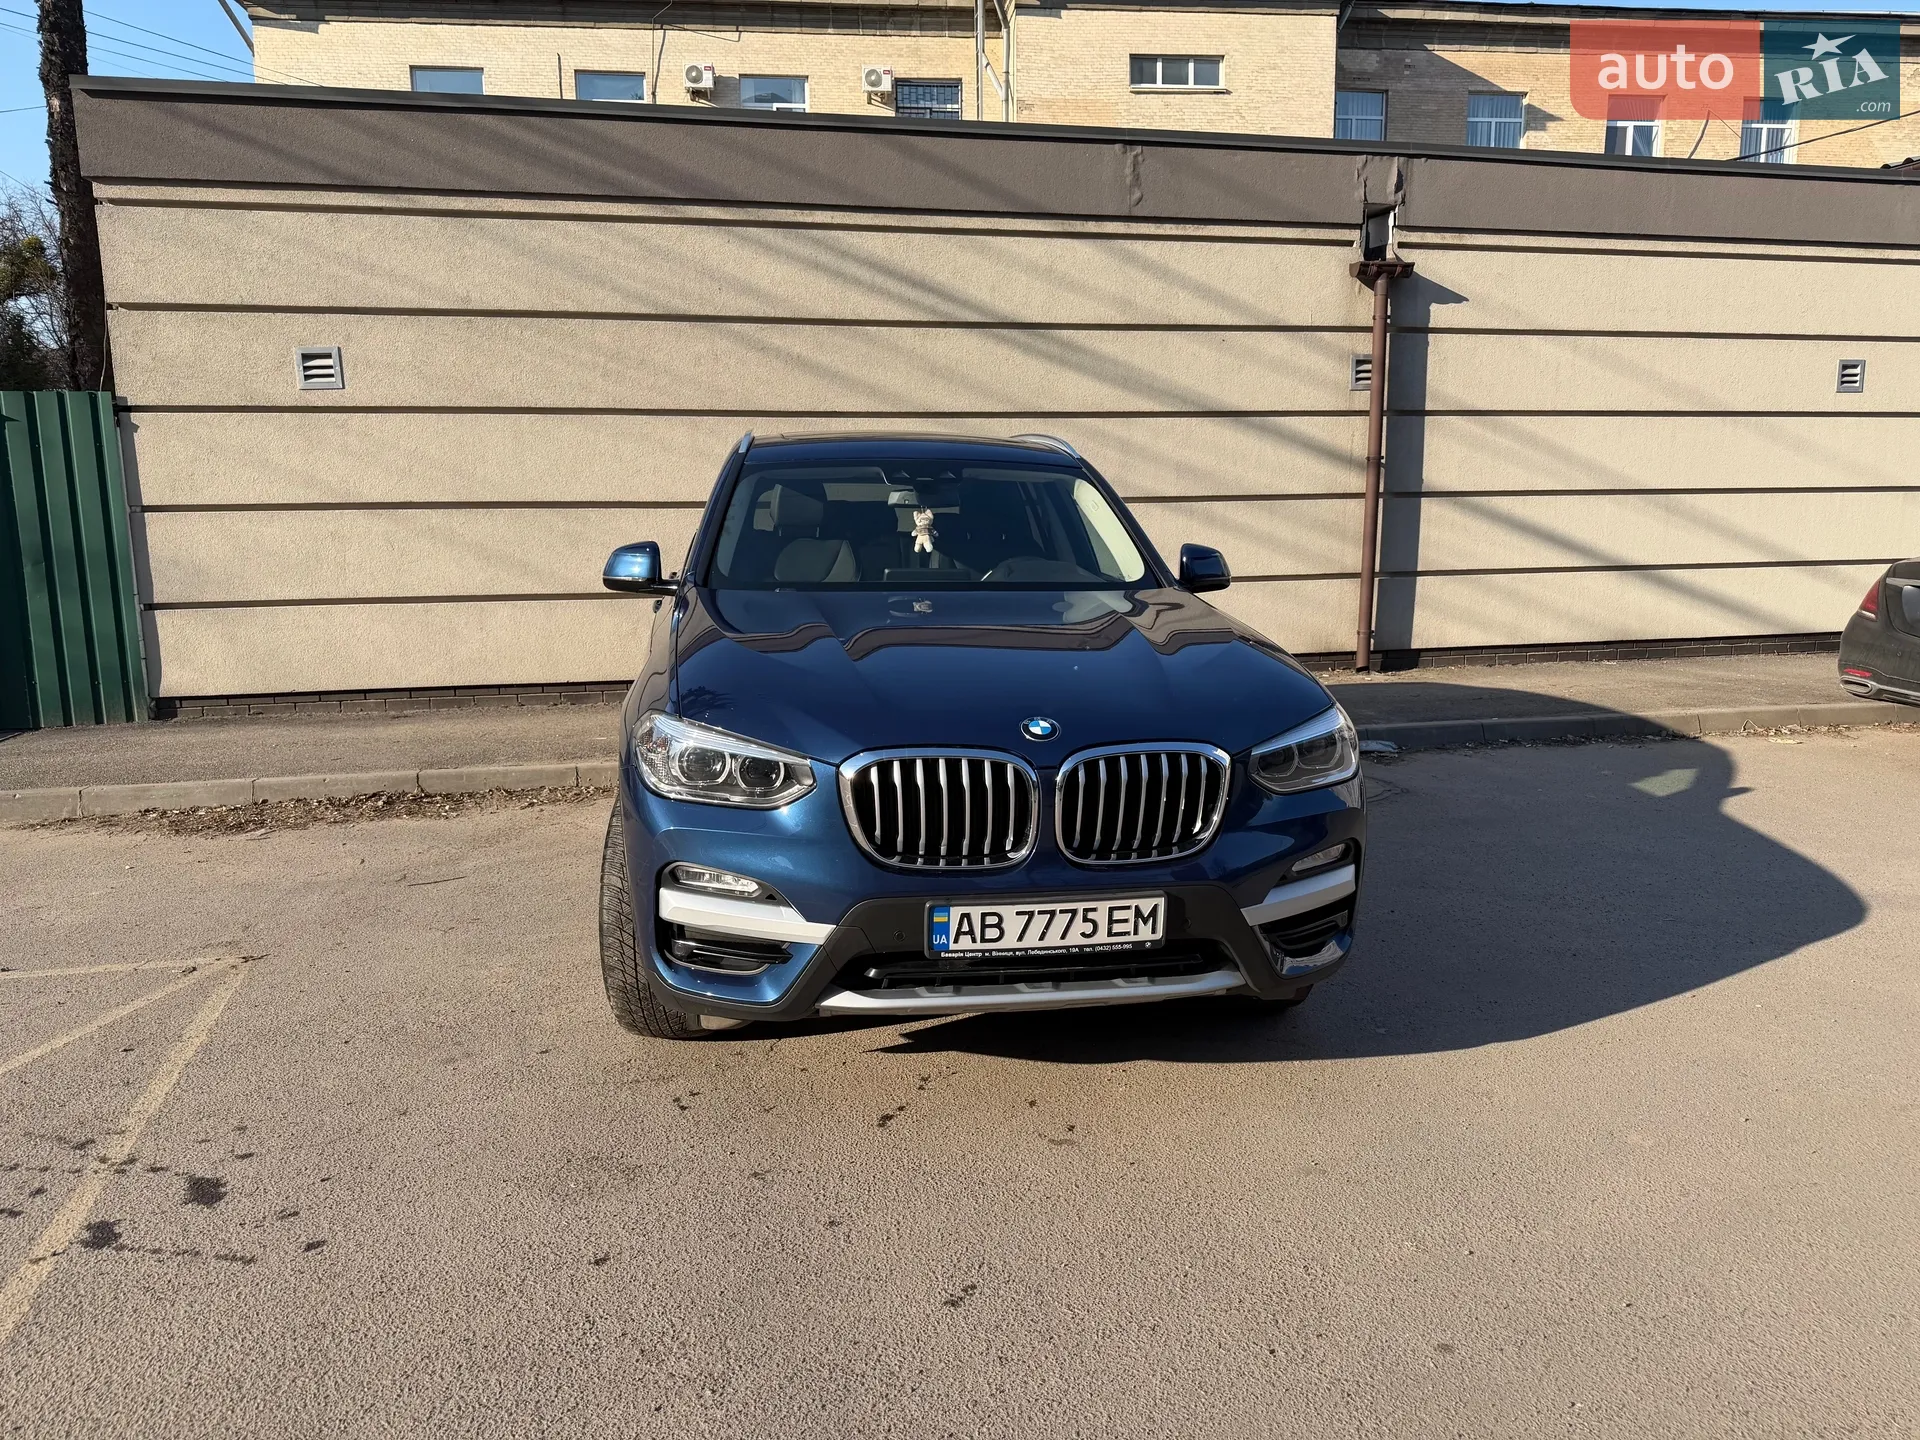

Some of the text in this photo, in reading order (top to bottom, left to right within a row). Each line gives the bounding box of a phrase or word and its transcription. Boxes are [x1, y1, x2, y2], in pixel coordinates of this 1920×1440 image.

[952, 903, 1159, 944] AB 7775 EM
[932, 934, 948, 945] UA
